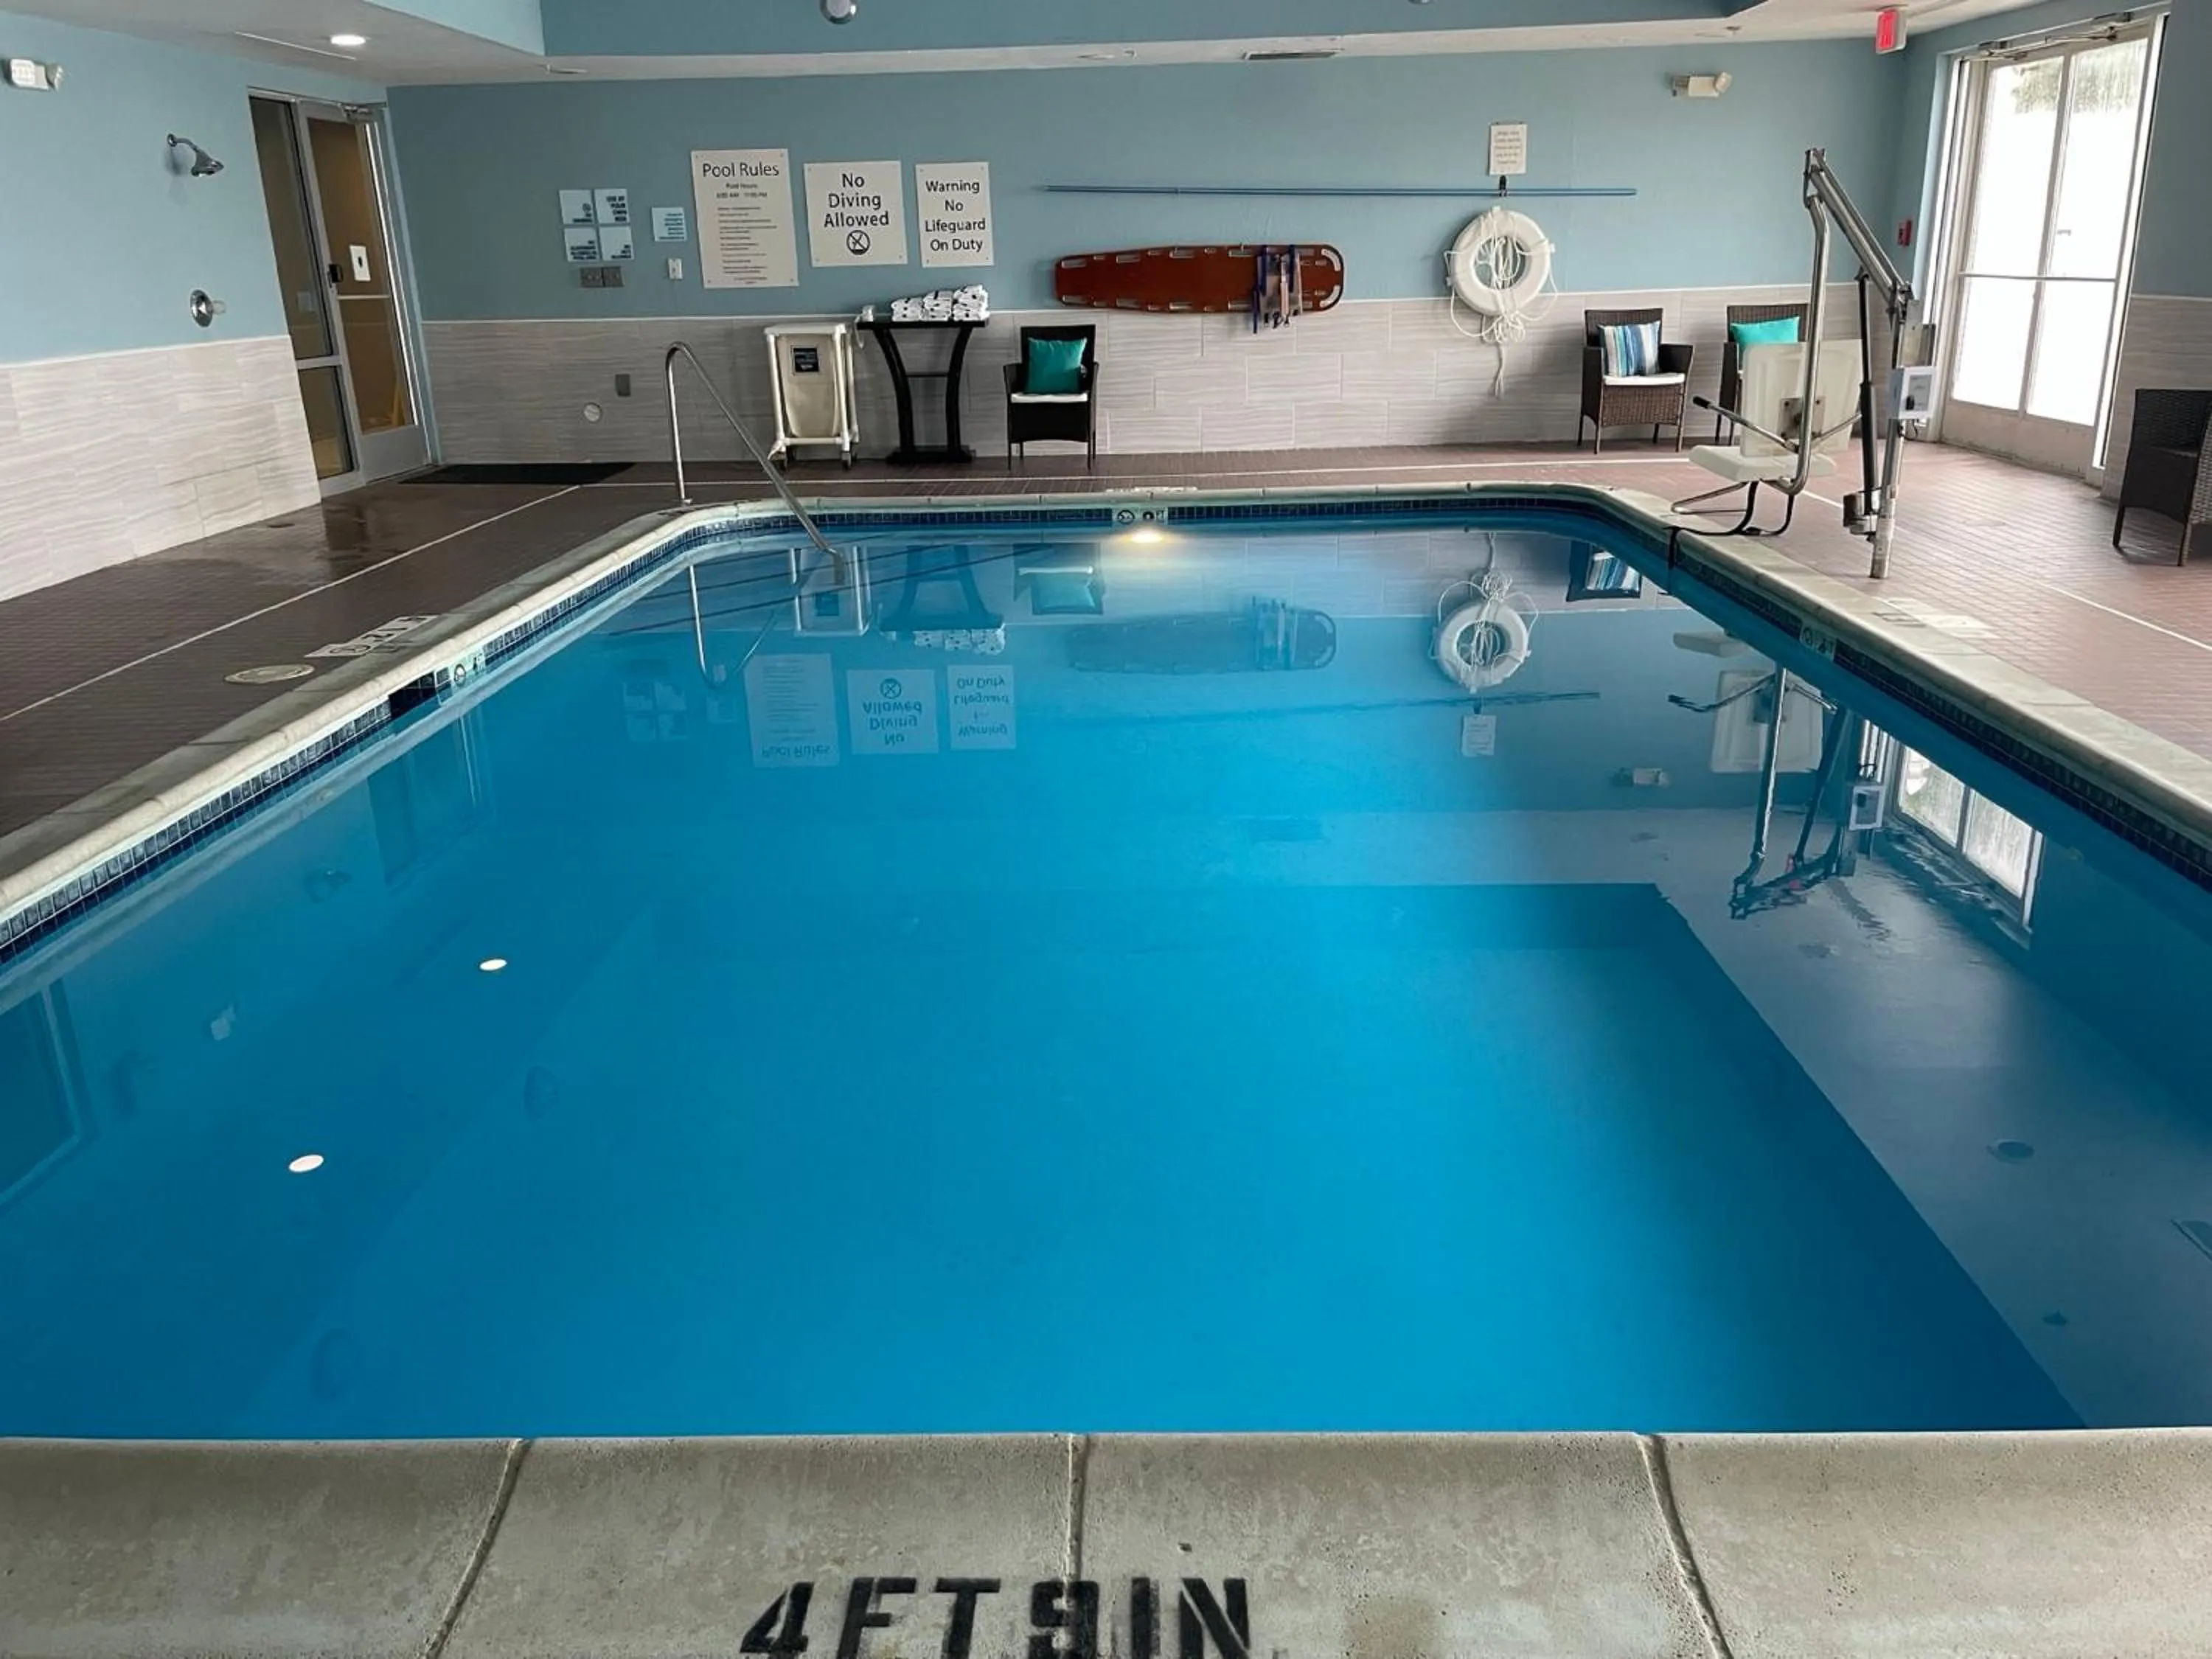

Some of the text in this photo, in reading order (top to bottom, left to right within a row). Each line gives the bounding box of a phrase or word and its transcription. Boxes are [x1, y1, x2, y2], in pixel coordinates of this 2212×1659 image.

[702, 161, 780, 178] Pool Rules
[841, 173, 866, 188] No
[925, 179, 981, 194] Warning
[827, 192, 882, 210] Diving
[944, 200, 964, 212] No
[823, 210, 890, 228] Allowed
[924, 217, 987, 234] Lifeguard
[929, 237, 984, 253] On Duty
